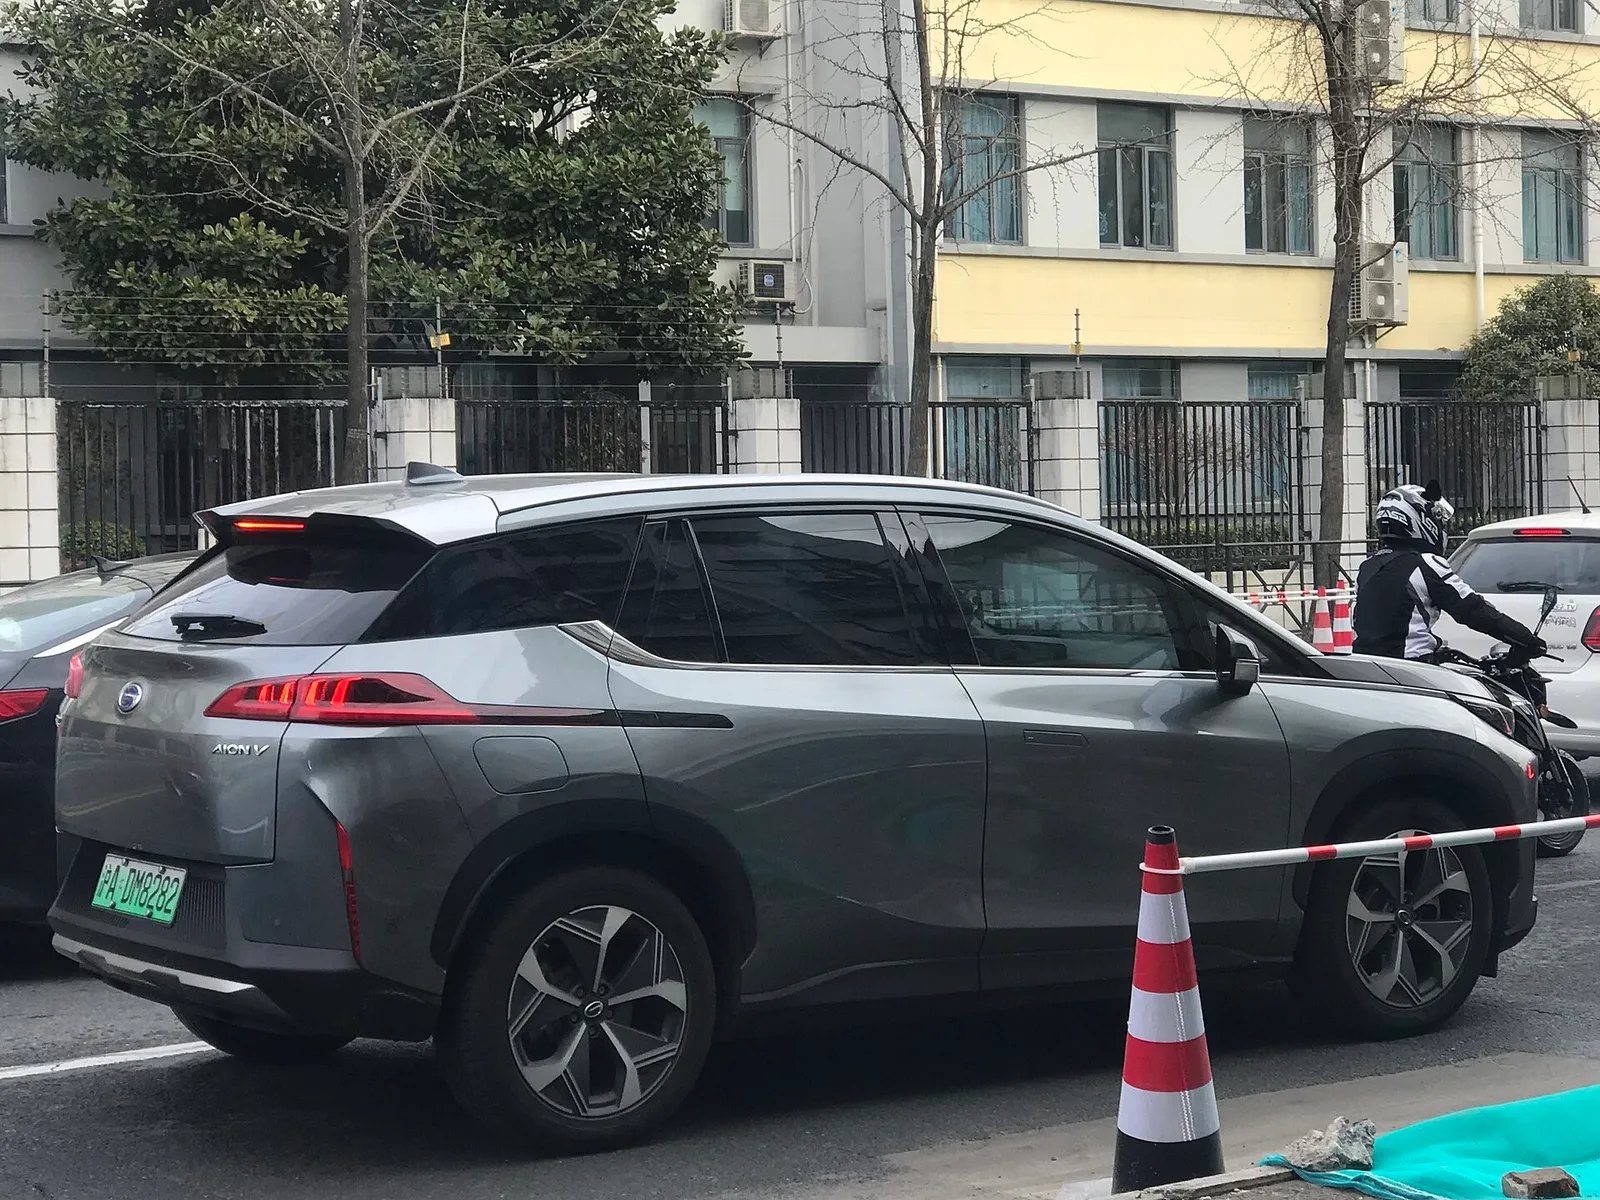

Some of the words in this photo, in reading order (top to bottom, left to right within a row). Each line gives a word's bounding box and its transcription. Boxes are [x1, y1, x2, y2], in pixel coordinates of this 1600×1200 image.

[212, 743, 251, 755] AION
[253, 744, 270, 756] V
[120, 867, 180, 914] DM8282
